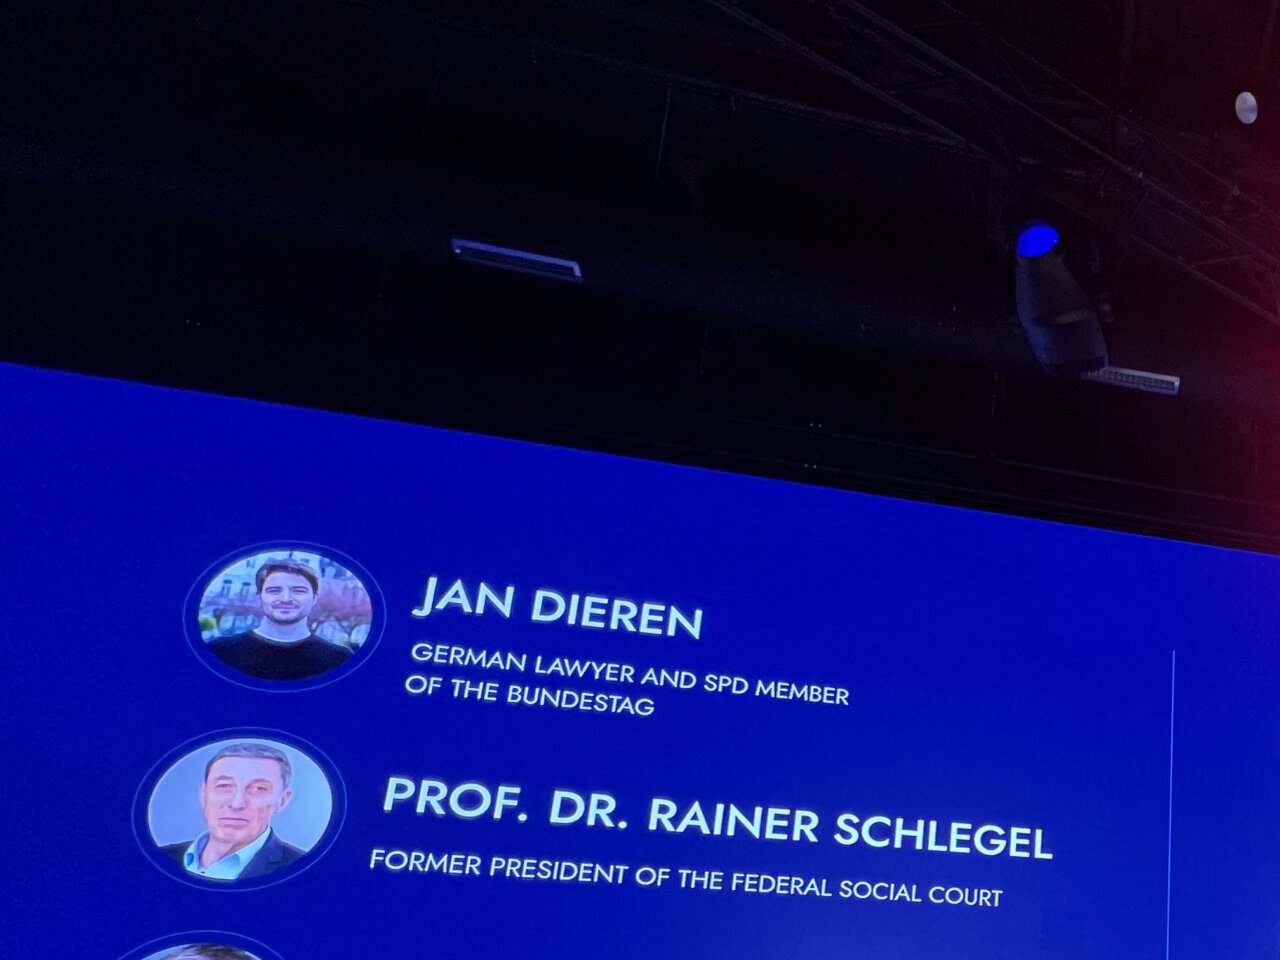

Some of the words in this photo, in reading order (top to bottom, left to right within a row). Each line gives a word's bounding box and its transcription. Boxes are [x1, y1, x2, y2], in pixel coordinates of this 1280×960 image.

[411, 576, 515, 618] JAN
[531, 589, 703, 640] DIEREN
[404, 674, 443, 695] OF
[451, 678, 500, 701] THE
[507, 684, 655, 716] BUNDESTAG
[411, 642, 528, 672] GERMAN
[534, 655, 635, 683] LAWYER
[640, 667, 697, 689] AND
[703, 673, 749, 695] SPD
[755, 679, 850, 706] MEMBER
[383, 776, 528, 822] PROF.
[549, 789, 628, 830] DR.
[648, 797, 820, 843] RAINER
[833, 812, 1054, 860] SCHLEGEL
[369, 848, 482, 876] FORMER
[489, 856, 630, 884] PRESIDENT
[635, 866, 671, 887] OF
[678, 869, 724, 890] THE
[731, 872, 833, 897] FEDERAL
[838, 879, 923, 903] SOCIAL
[928, 885, 1004, 907] COURT
